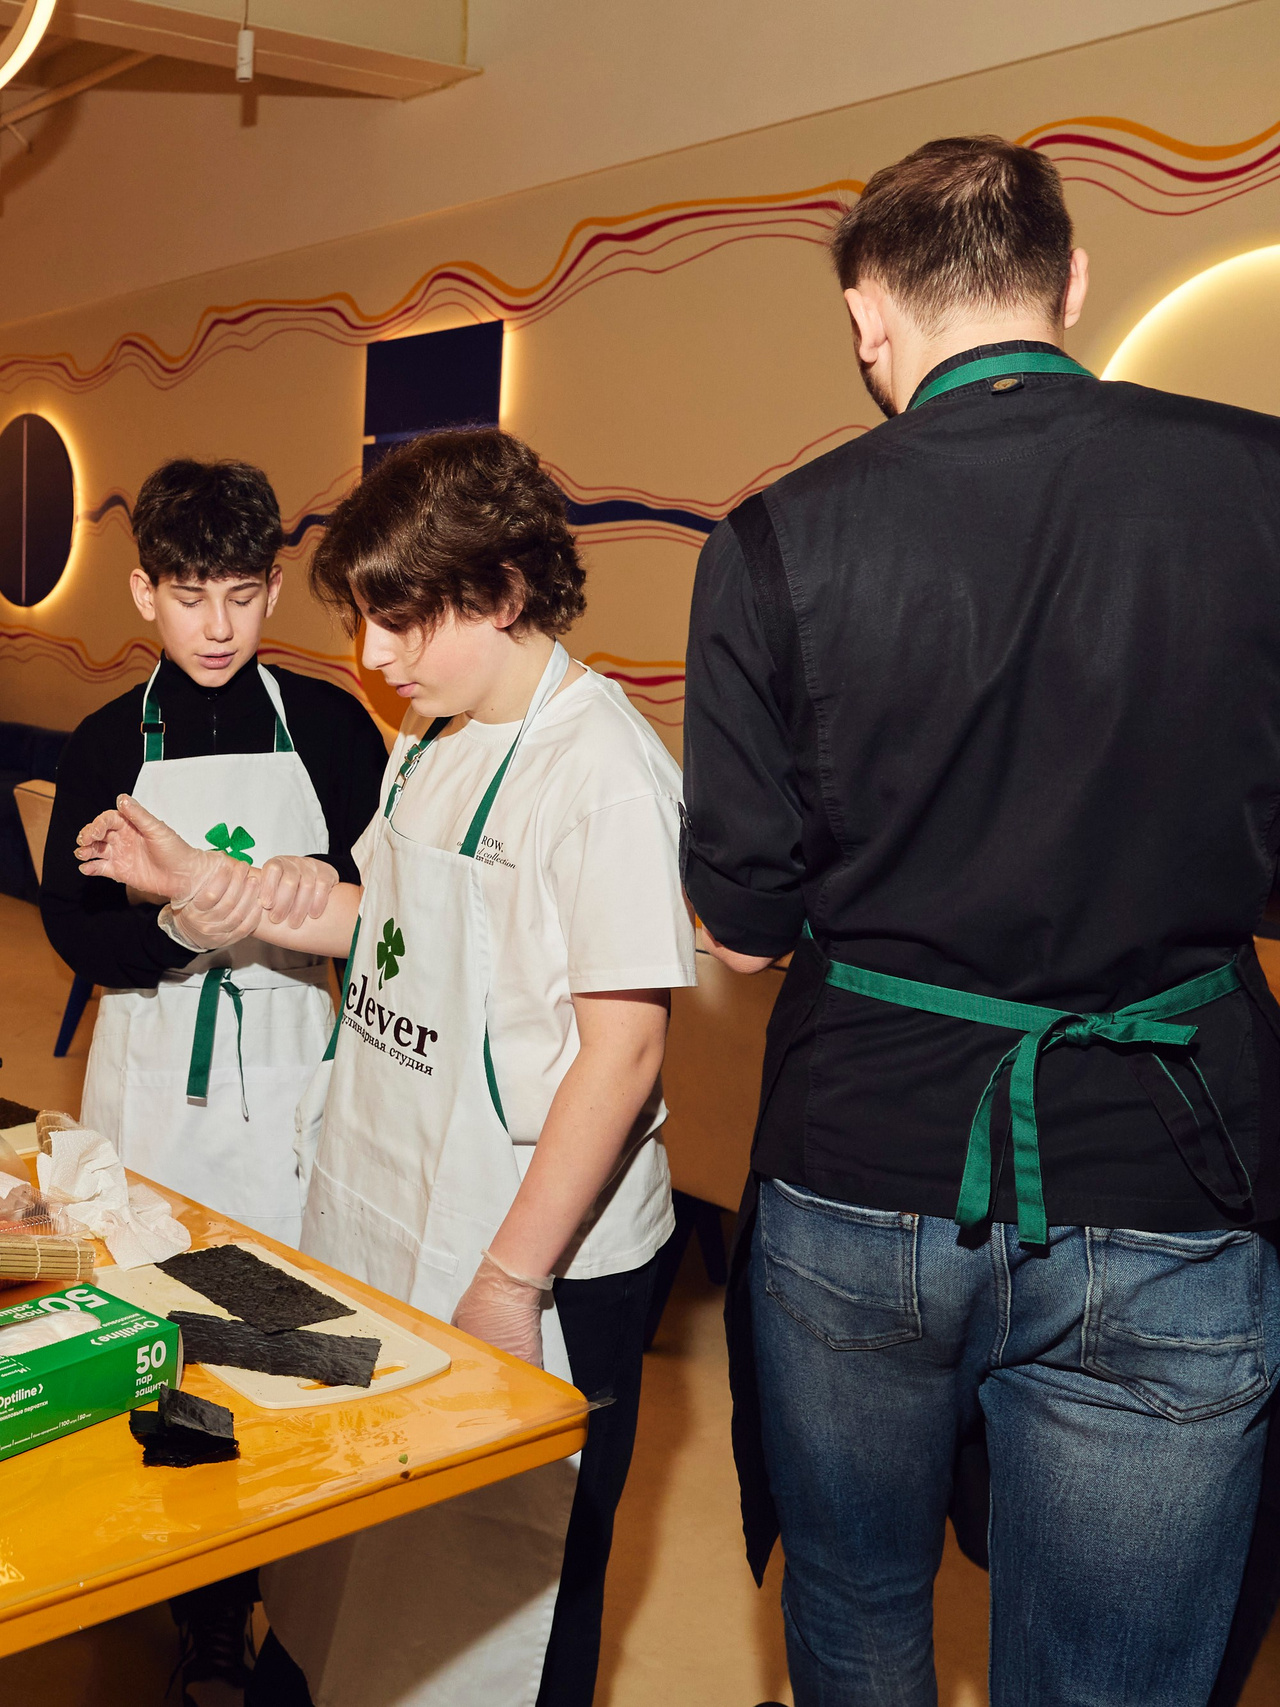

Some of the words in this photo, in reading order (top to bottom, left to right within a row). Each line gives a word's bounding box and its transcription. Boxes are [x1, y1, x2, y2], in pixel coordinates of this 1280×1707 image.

[483, 852, 516, 869] collection
[346, 974, 438, 1057] clever
[342, 1012, 386, 1053] улинарная
[389, 1046, 434, 1076] студия
[38, 1288, 109, 1312] 50
[97, 1320, 159, 1343] Optiline
[136, 1340, 167, 1374] 50
[135, 1373, 153, 1387] пар
